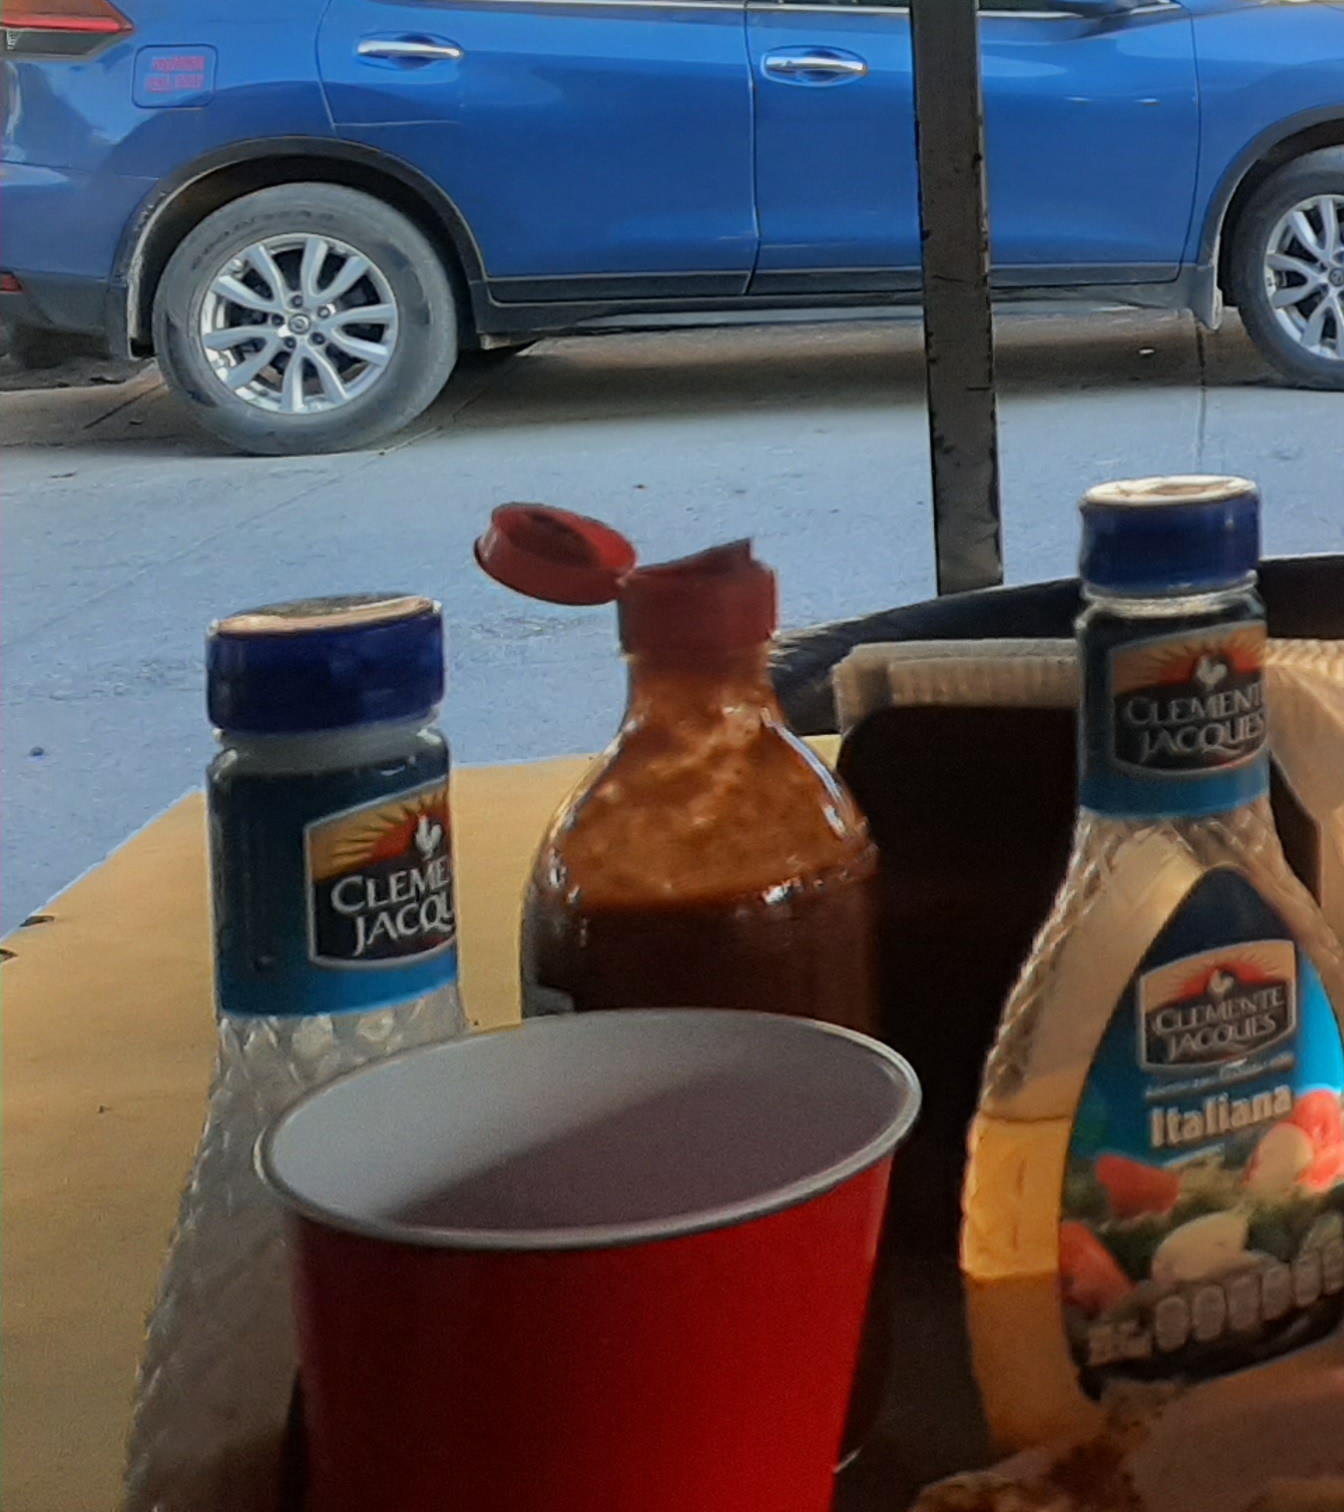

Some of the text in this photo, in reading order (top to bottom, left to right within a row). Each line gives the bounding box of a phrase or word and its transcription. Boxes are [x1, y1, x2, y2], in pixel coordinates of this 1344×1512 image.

[1153, 986, 1286, 1036] CLEMENTE
[1168, 1012, 1277, 1062] JACQUES
[1151, 1084, 1292, 1147] Italiana
